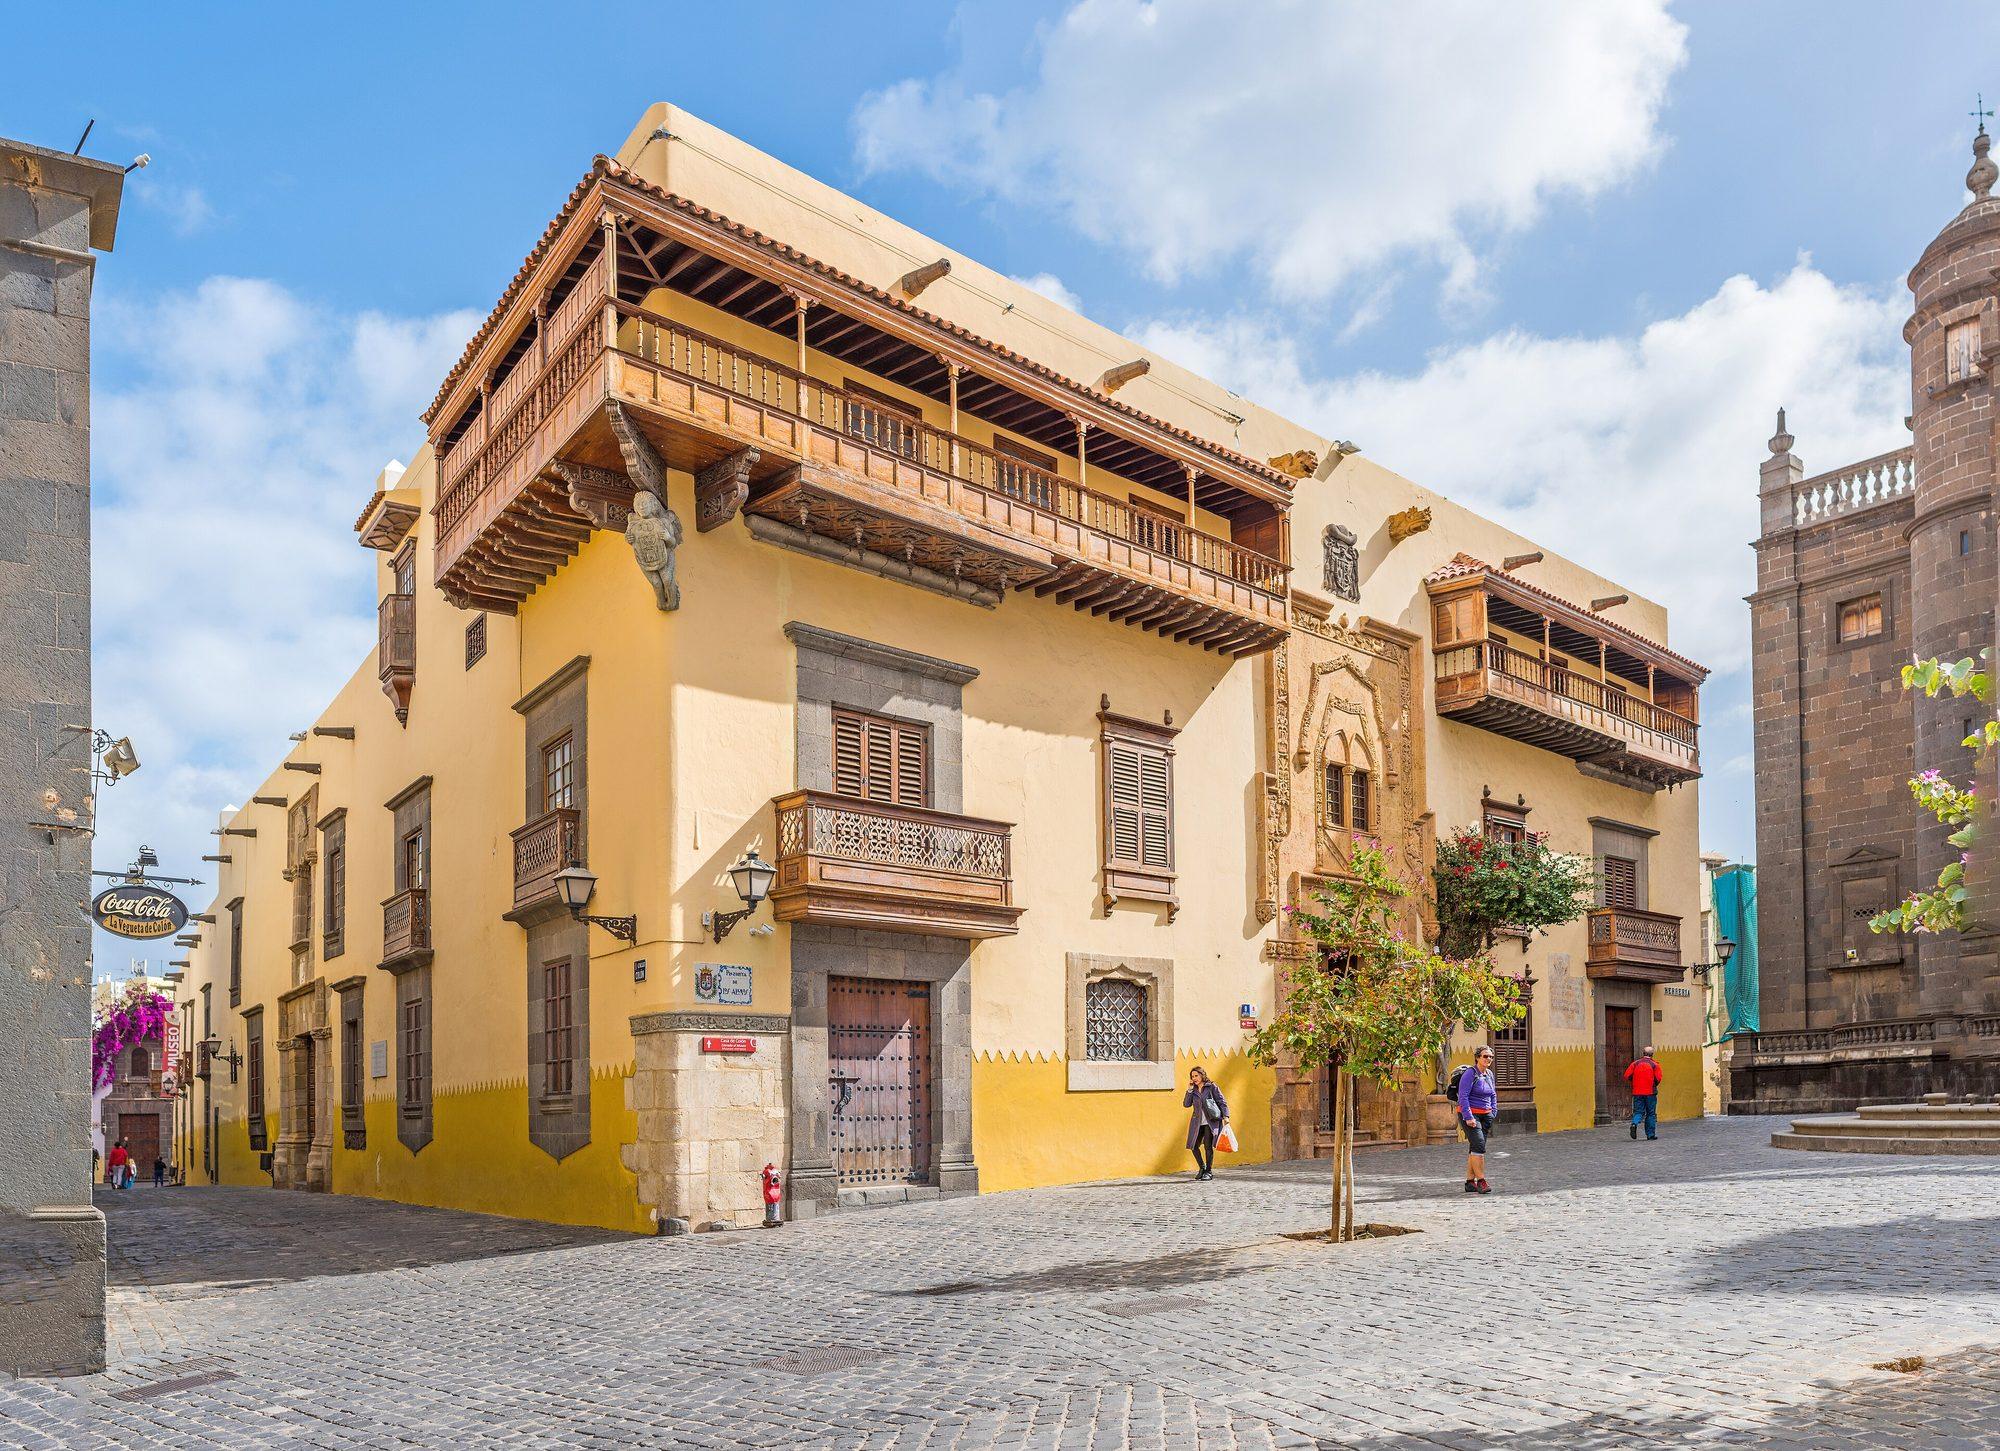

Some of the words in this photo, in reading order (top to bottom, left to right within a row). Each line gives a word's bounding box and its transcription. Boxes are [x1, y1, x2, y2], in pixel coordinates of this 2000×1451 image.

[100, 893, 173, 918] Coca-Cola
[110, 915, 117, 928] La
[118, 919, 144, 935] Vegueta
[144, 924, 152, 933] de
[153, 921, 172, 933] Colón
[168, 1027, 180, 1067] MUSEO
